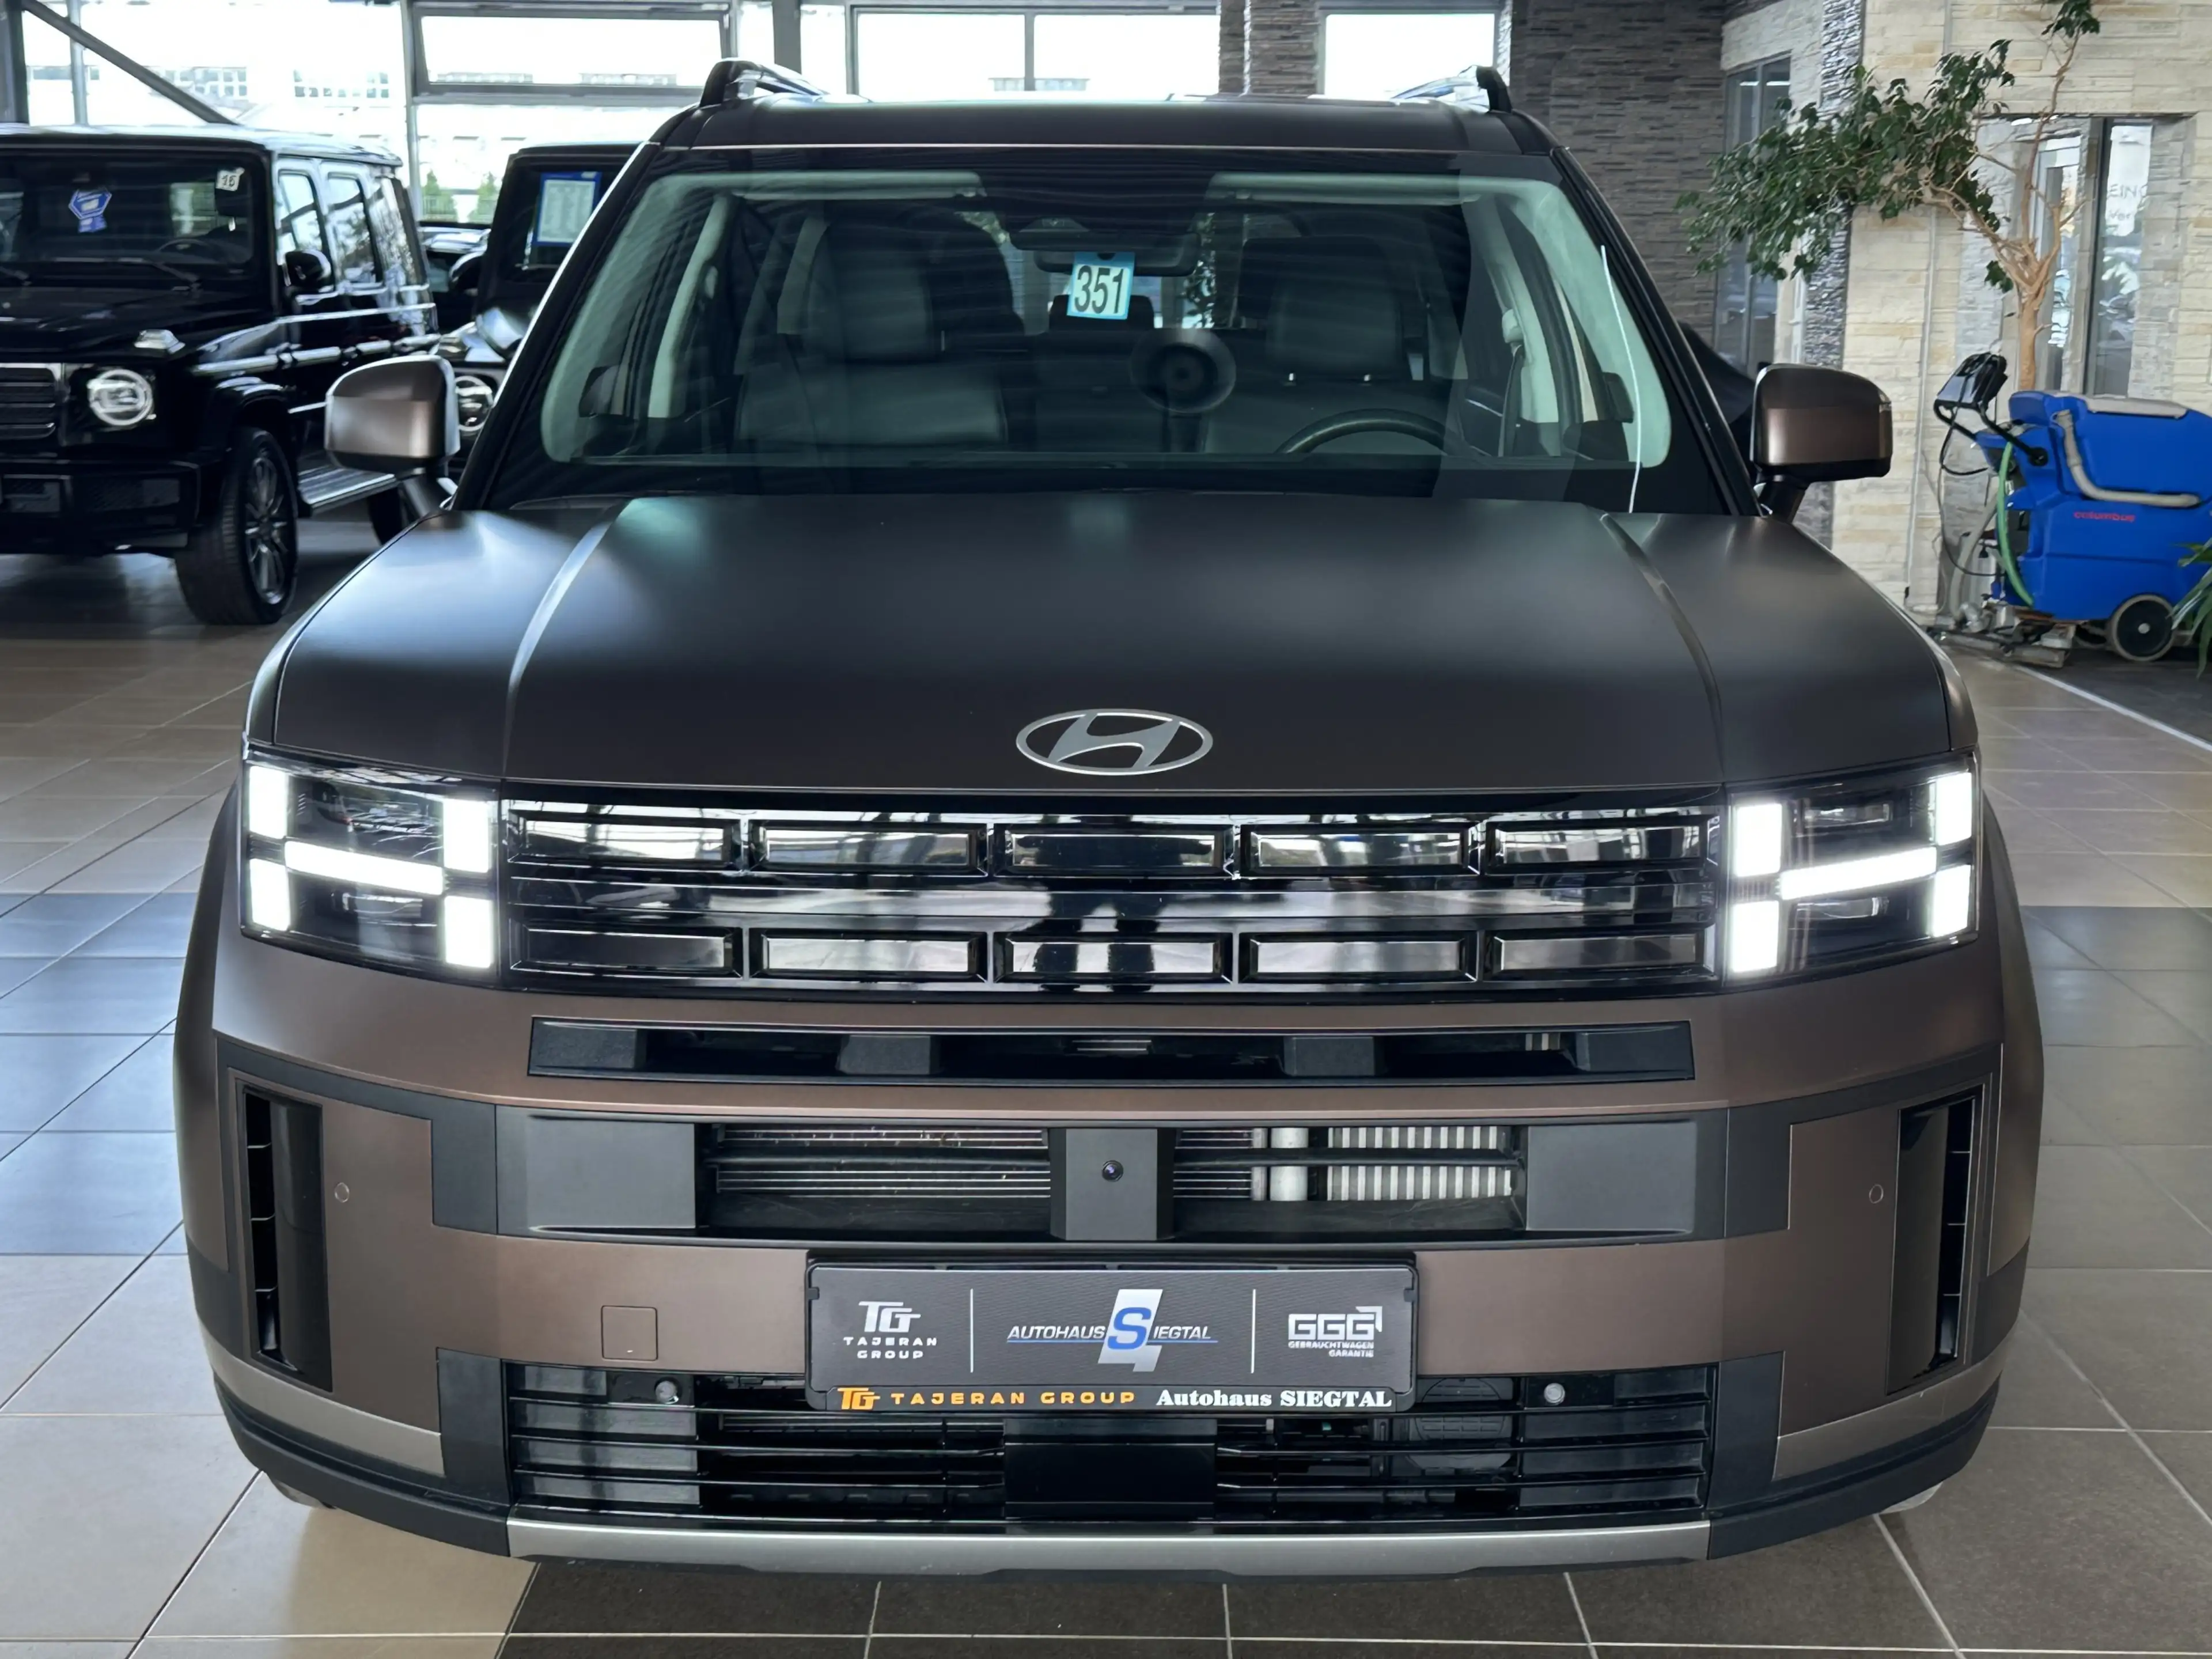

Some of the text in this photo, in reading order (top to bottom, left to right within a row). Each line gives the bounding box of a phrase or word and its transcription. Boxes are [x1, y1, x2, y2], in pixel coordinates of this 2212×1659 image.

[1074, 265, 1124, 314] 351
[1007, 1325, 1107, 1340] AUTOHAUS
[1288, 1313, 1375, 1340] GGG
[843, 1336, 938, 1346] TAJERAN
[1288, 1340, 1374, 1349] GEBRAUCHTWAGEN
[857, 1350, 923, 1359] GROUP
[1328, 1349, 1374, 1358] GARANTIE
[891, 1392, 1025, 1405] TAJERAN
[1040, 1392, 1136, 1404] GROUP
[1156, 1389, 1393, 1407] Autohaus SIEGTAL
